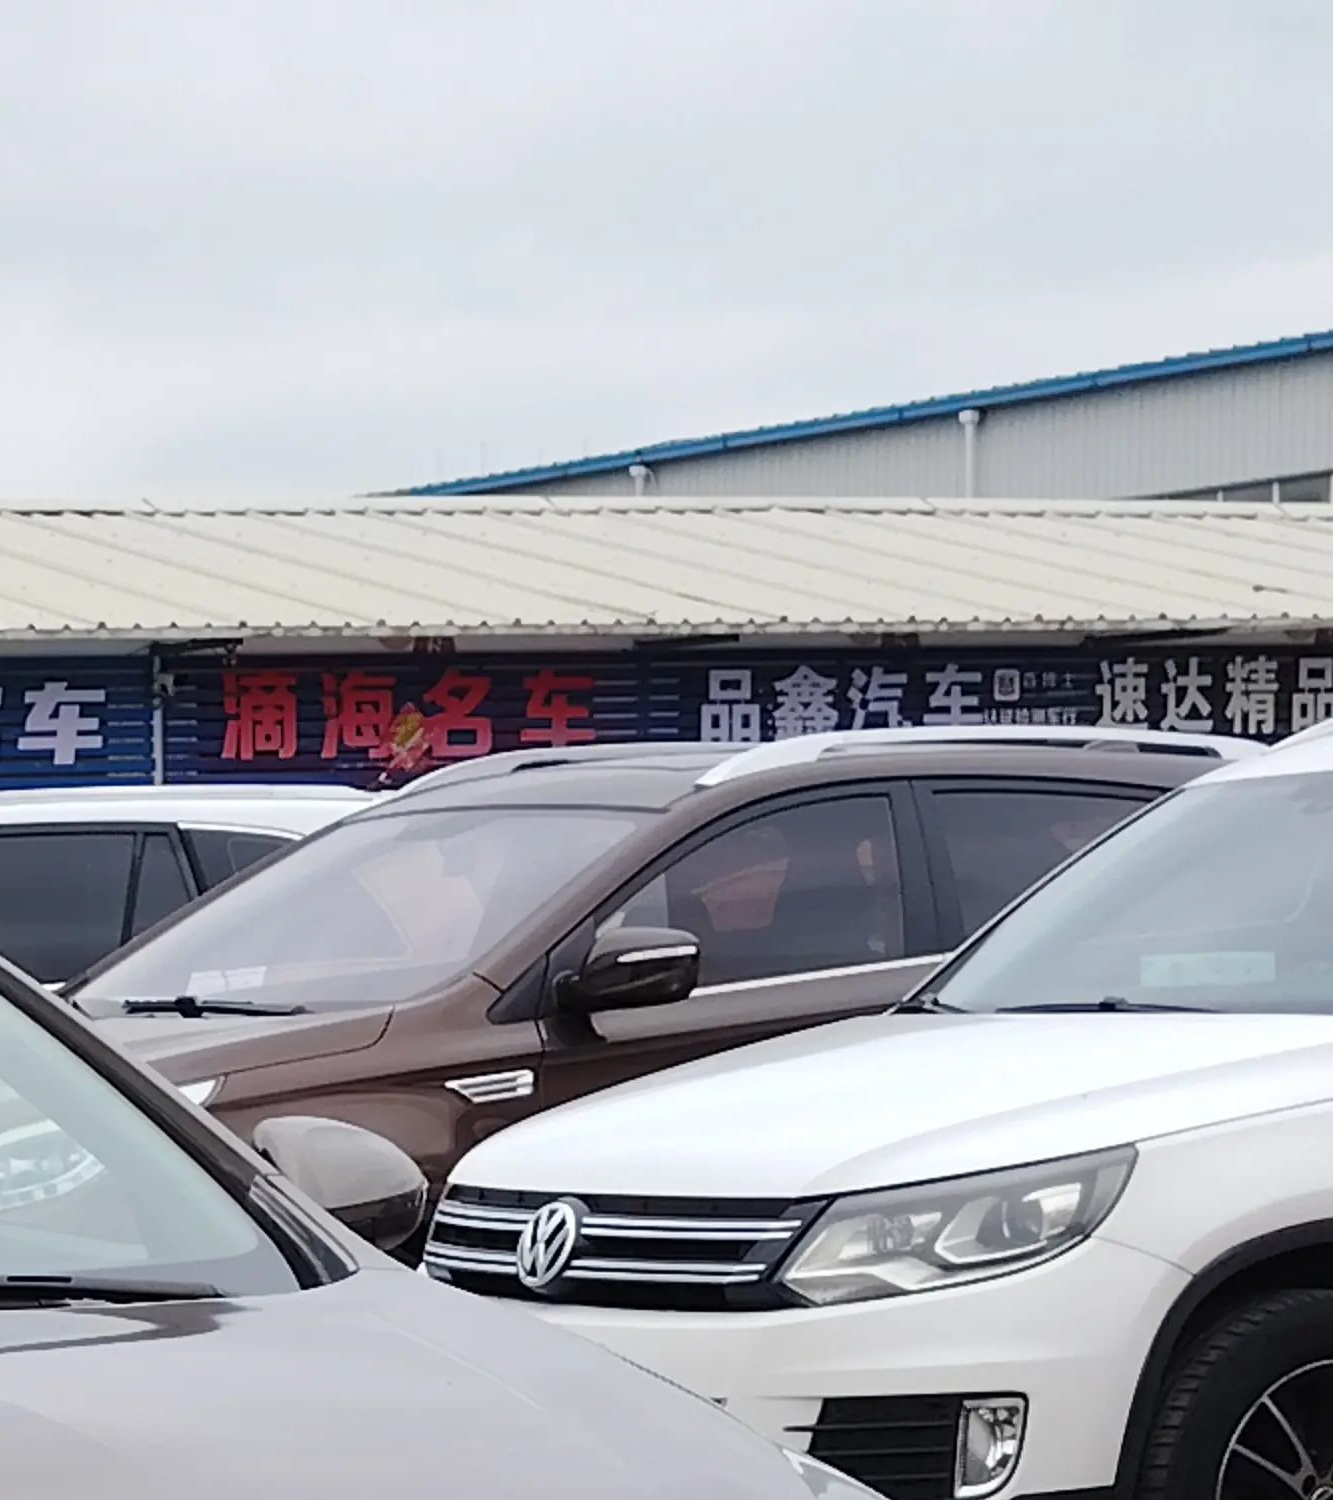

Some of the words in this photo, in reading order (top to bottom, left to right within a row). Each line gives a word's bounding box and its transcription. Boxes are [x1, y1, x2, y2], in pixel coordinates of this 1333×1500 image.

[221, 669, 597, 760] 滴海名车
[701, 663, 983, 742] 品鑫汽车
[1095, 655, 1333, 735] 速达精品
